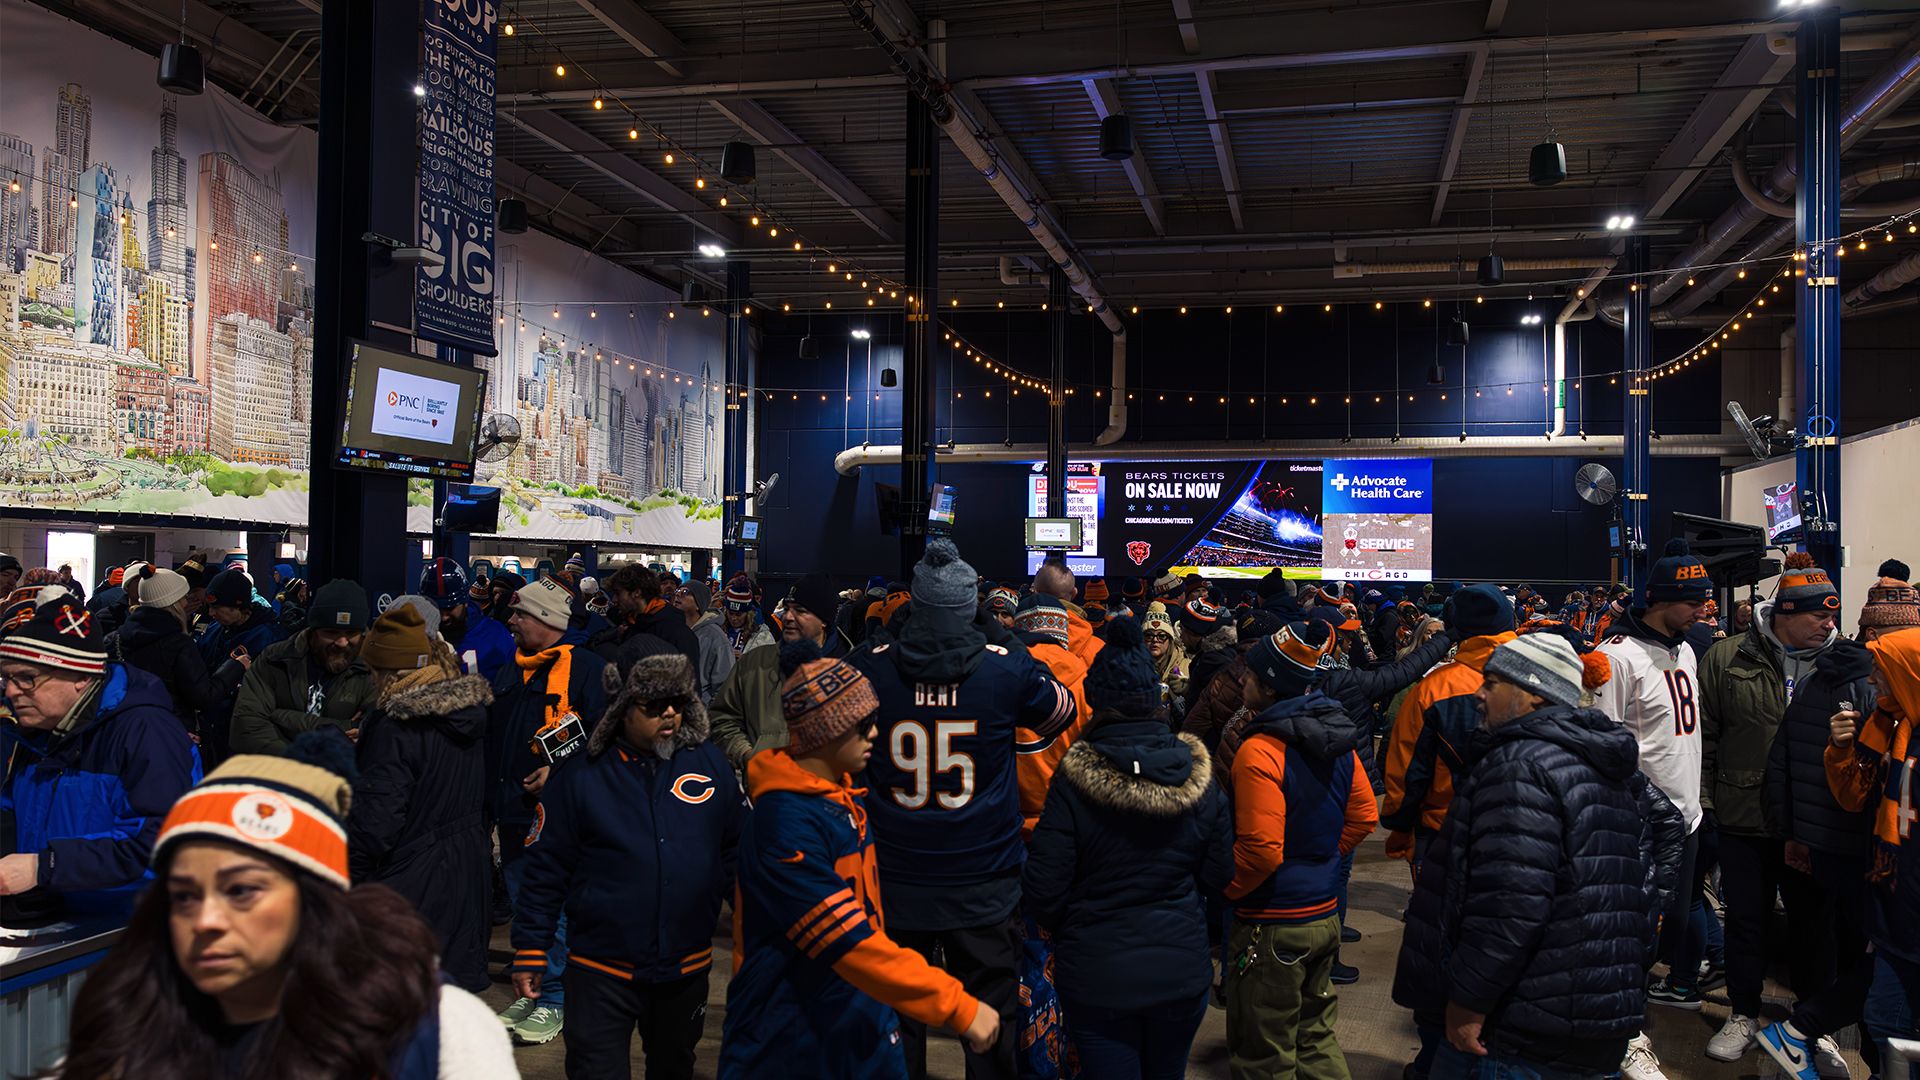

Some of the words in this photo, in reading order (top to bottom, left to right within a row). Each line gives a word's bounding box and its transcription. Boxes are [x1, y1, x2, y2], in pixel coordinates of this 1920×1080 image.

[439, 8, 483, 43] LANDING
[424, 45, 451, 72] THE
[452, 61, 495, 97] WORLD
[445, 42, 477, 71] BUTCHER
[480, 64, 496, 81] FOR
[424, 65, 457, 94] TOOL
[458, 84, 493, 116] MAKER
[422, 95, 464, 125] PLAYER
[468, 118, 494, 141] WITH
[456, 101, 466, 112] OF
[467, 106, 494, 128] WHEAT
[422, 107, 494, 157] RAILROADS
[443, 135, 456, 150] THE
[457, 144, 493, 168] NATION'S
[421, 167, 493, 214] BRAWLING
[462, 170, 493, 193] HUSKY
[420, 200, 460, 231] CITY
[467, 221, 493, 242] OF
[421, 220, 493, 295] BIG
[419, 279, 493, 317] SHOULDERS
[399, 394, 420, 410] PNC
[413, 465, 430, 473] SERVICE
[1037, 480, 1047, 489] DI
[1125, 472, 1168, 480] BEARS
[1171, 472, 1225, 480] TICKETS
[1351, 474, 1408, 486] Advocate
[1125, 483, 1145, 499] ON
[1147, 483, 1181, 499] SALE
[1185, 483, 1221, 499] NOW
[1351, 487, 1391, 499] Health
[1393, 488, 1424, 499] Care
[1359, 538, 1415, 550] SERVICE
[1345, 570, 1408, 580] CHICAGO
[914, 681, 960, 707] DENT
[1663, 669, 1696, 737] 18
[889, 719, 979, 810] 95
[670, 773, 716, 805] C
